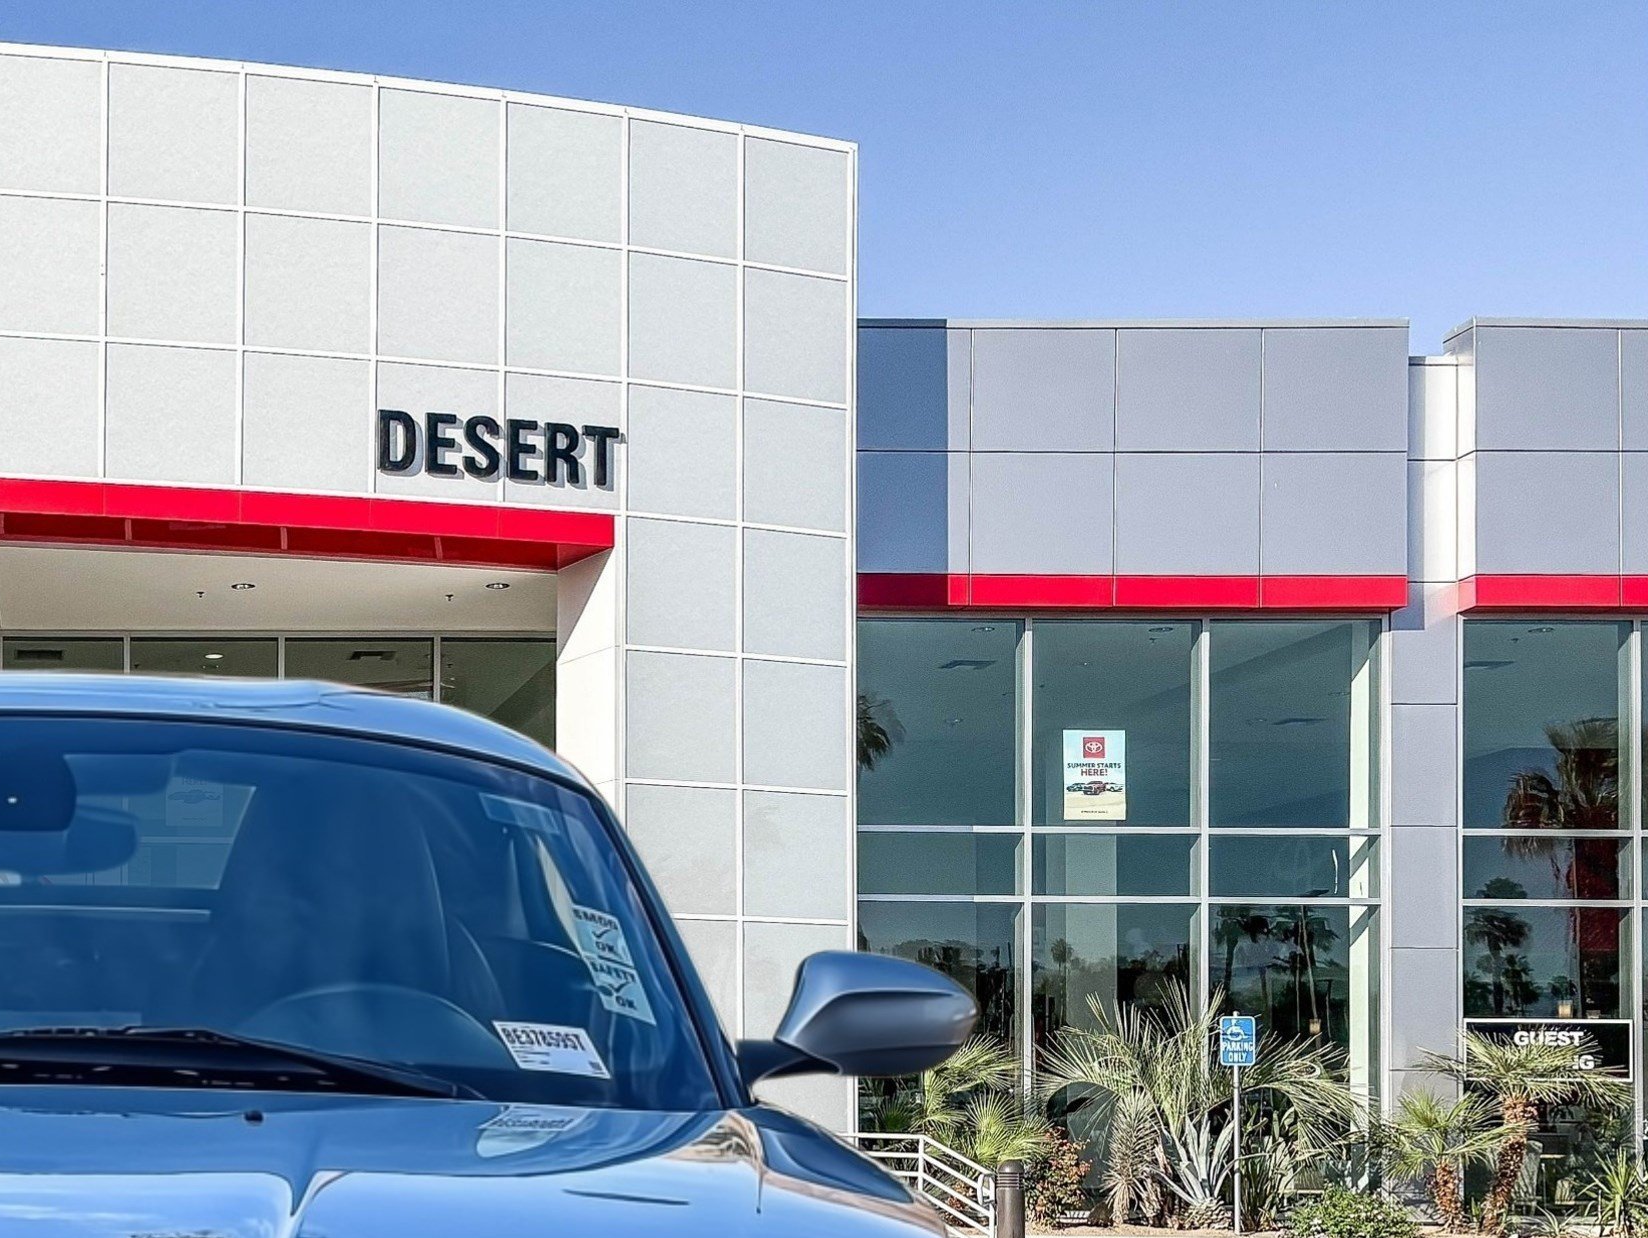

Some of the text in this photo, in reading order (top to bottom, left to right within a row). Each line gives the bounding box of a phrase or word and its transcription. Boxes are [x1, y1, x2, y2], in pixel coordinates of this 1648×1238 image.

[377, 409, 620, 486] DESERT
[1222, 1040, 1253, 1051] PARKING
[1513, 1031, 1584, 1047] GUEST
[1228, 1052, 1247, 1062] ONLY
